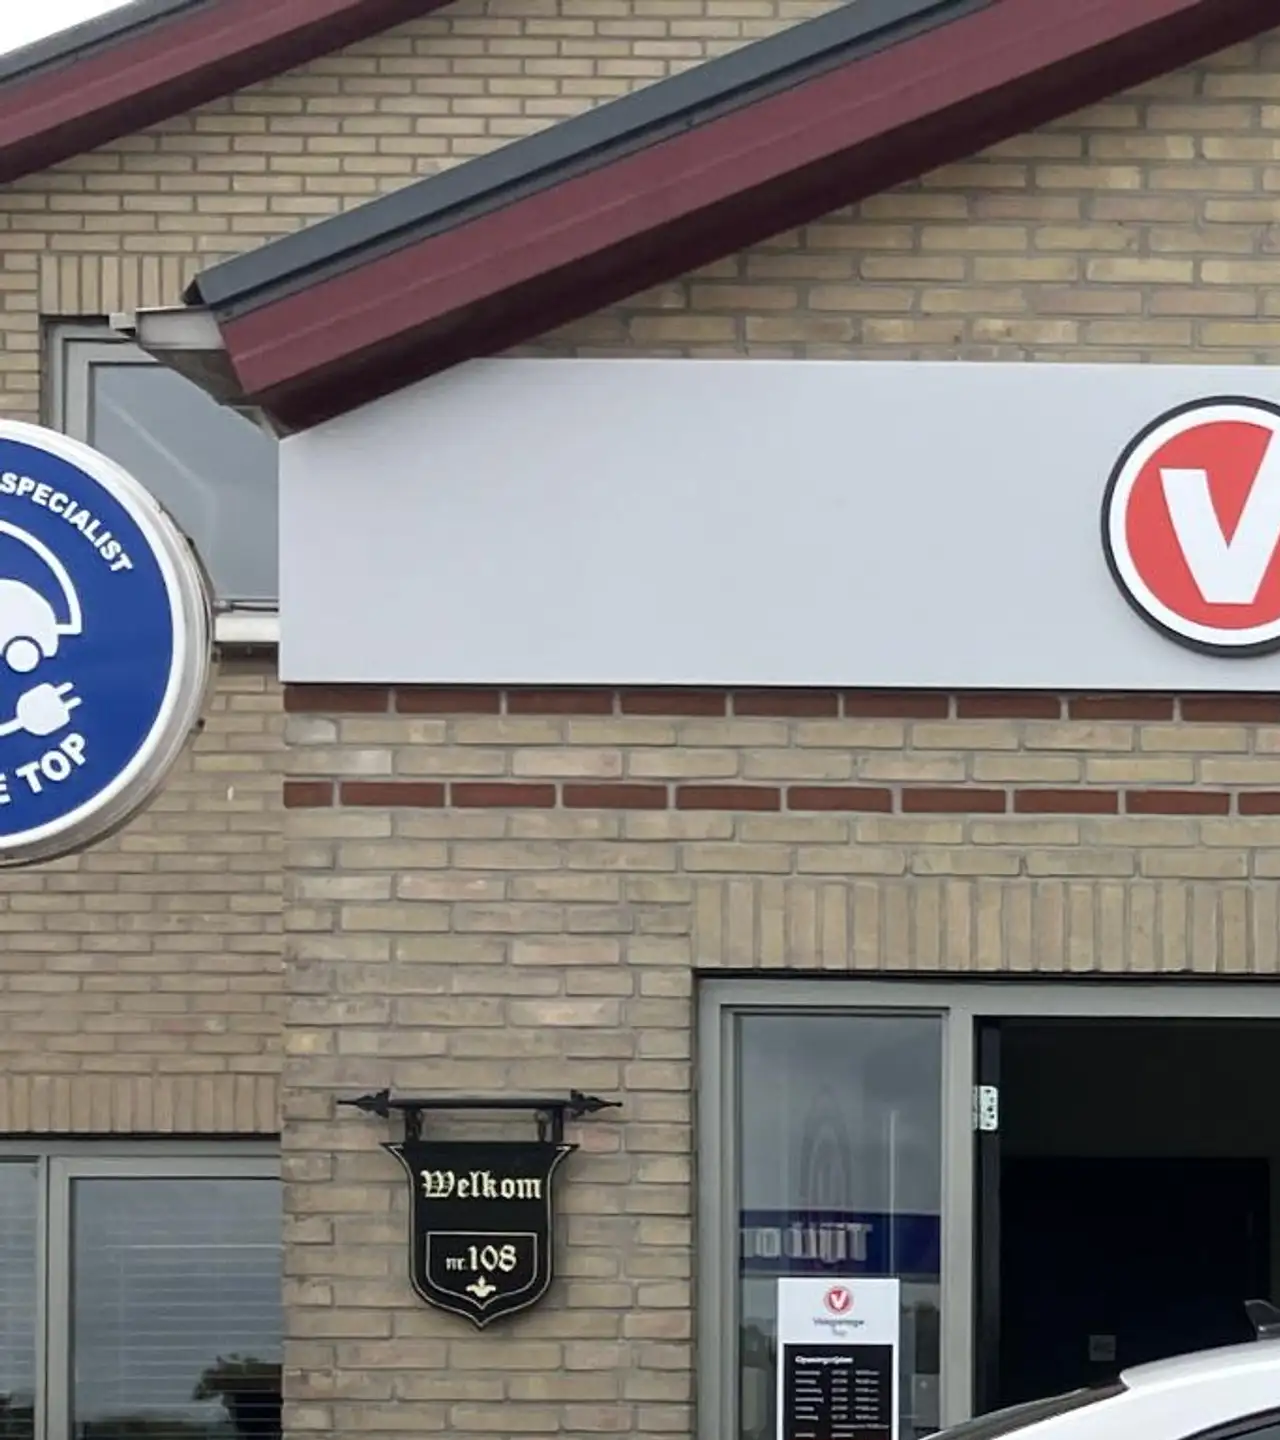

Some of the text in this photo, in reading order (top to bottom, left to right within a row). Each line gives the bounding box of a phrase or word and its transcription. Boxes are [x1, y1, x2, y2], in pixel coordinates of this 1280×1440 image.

[0, 472, 133, 571] SPECIALIST
[15, 732, 86, 793] TOP
[420, 1170, 541, 1199] Welkom
[468, 1245, 517, 1272] 108
